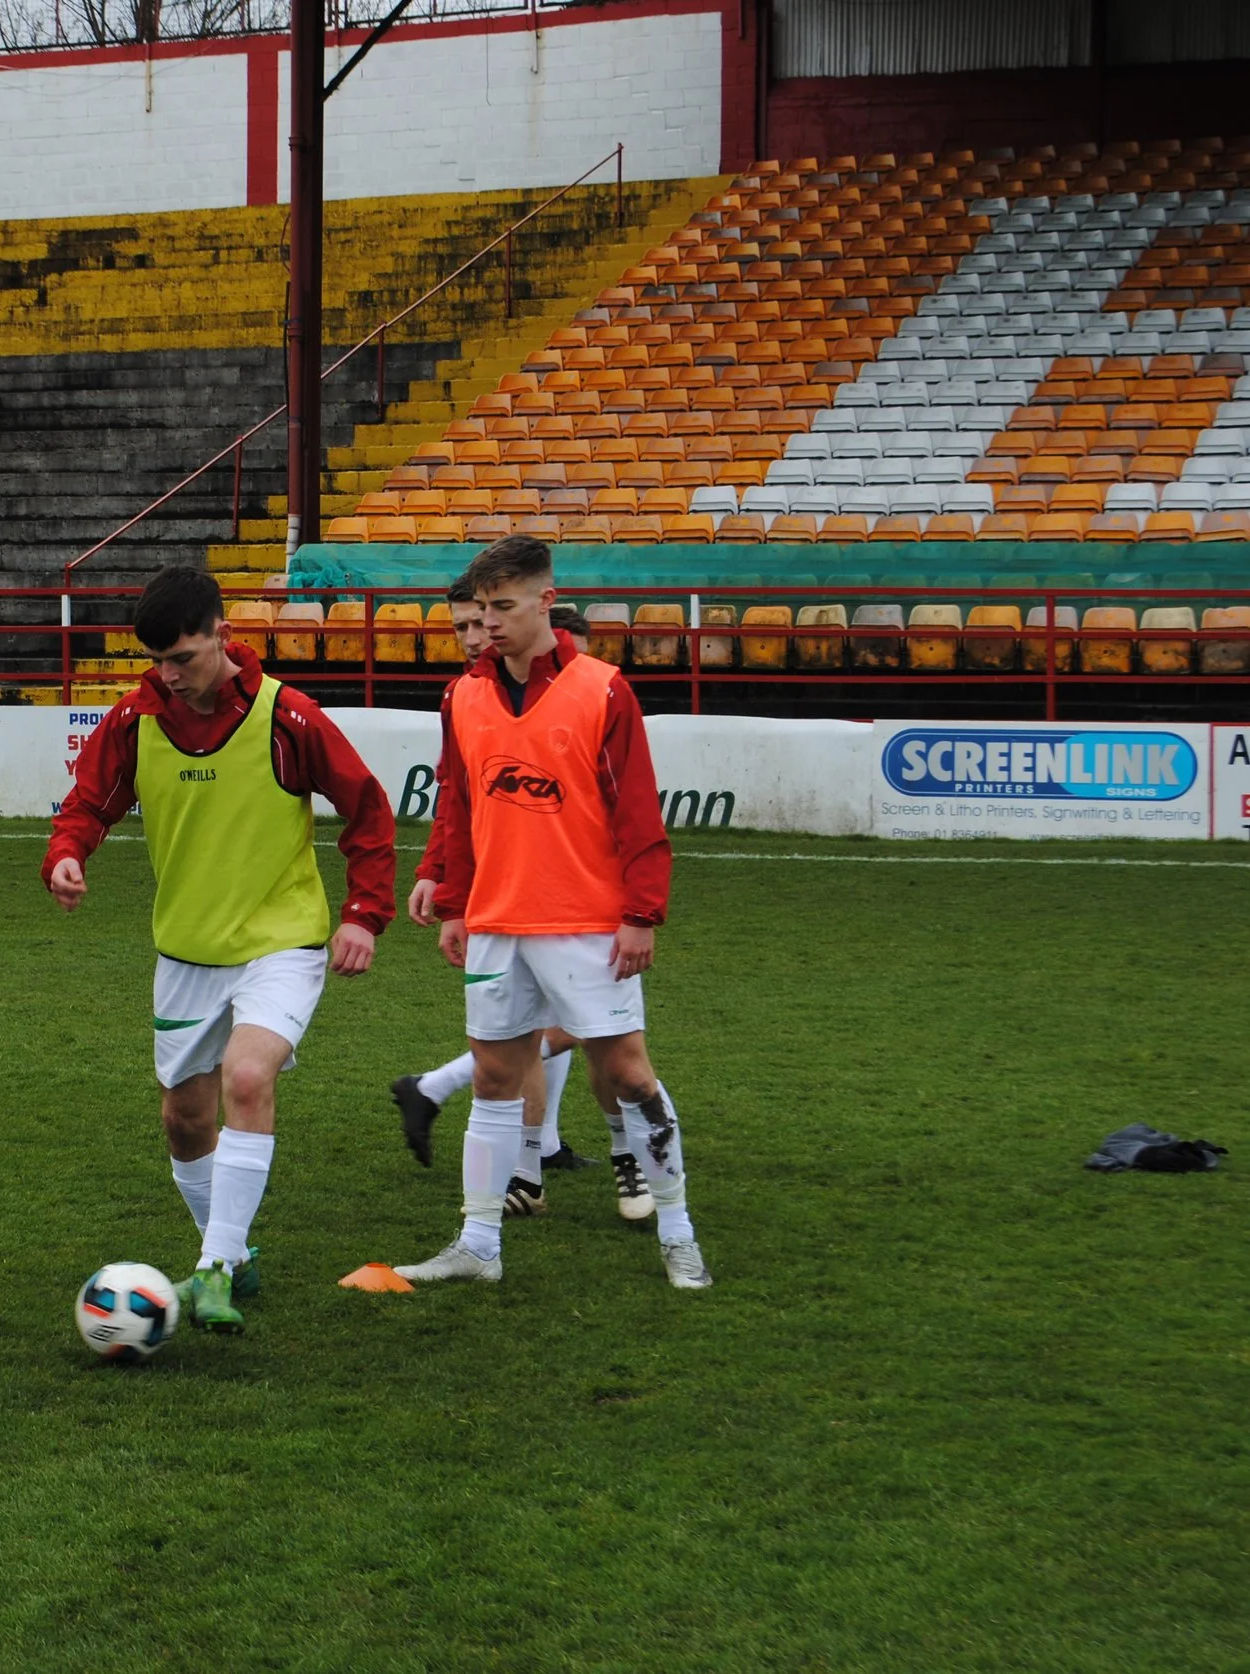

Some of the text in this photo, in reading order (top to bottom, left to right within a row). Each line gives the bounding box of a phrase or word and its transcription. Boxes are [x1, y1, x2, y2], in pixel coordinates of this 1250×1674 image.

[901, 739, 1180, 786] SCREENLINK
[179, 768, 217, 782] O'NEILLS
[954, 783, 1035, 794] PRINTERS
[1105, 787, 1158, 797] SIGNS
[881, 802, 1201, 825] Screen & Litho Printers, Signwriting & Lettering
